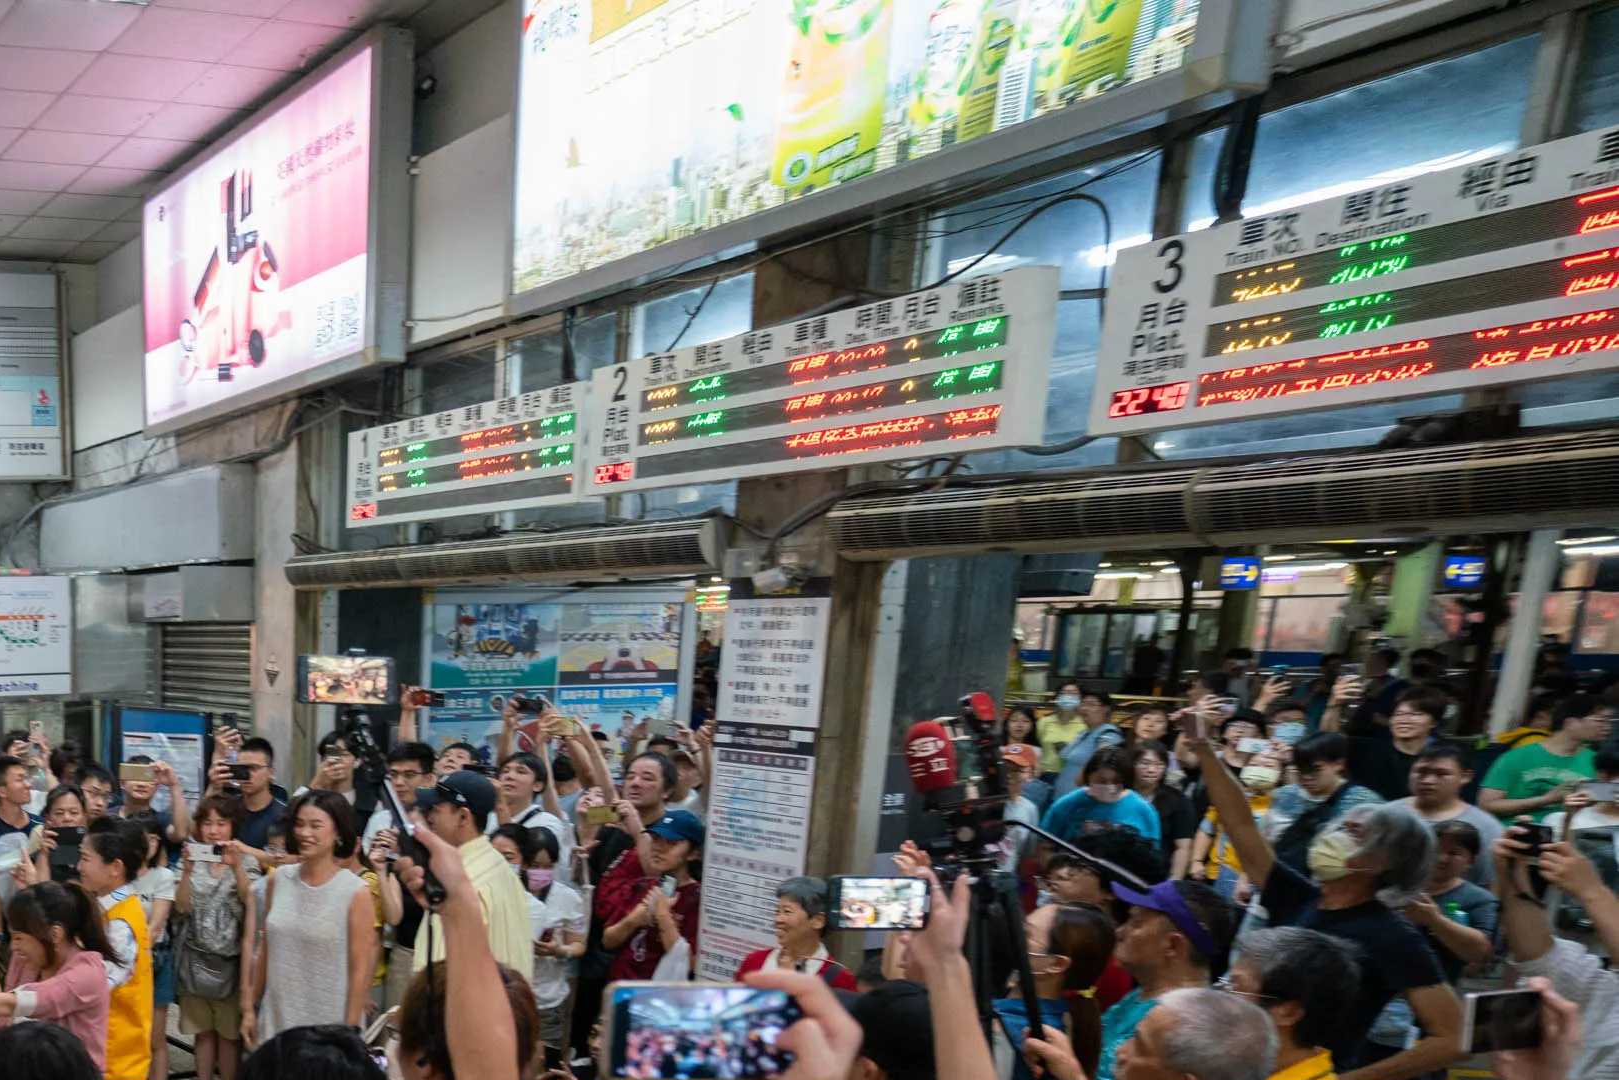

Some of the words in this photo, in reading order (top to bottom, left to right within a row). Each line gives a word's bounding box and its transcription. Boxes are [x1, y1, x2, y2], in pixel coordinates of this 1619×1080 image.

[1341, 185, 1413, 226] 開往
[1238, 213, 1301, 247] 車次
[1315, 213, 1431, 248] Destination
[1153, 239, 1185, 293] 3
[1223, 248, 1267, 268] Train
[949, 303, 1005, 323] Remarks
[1136, 298, 1187, 332] 月台
[1131, 330, 1185, 357] Plat.
[613, 366, 627, 402] 2
